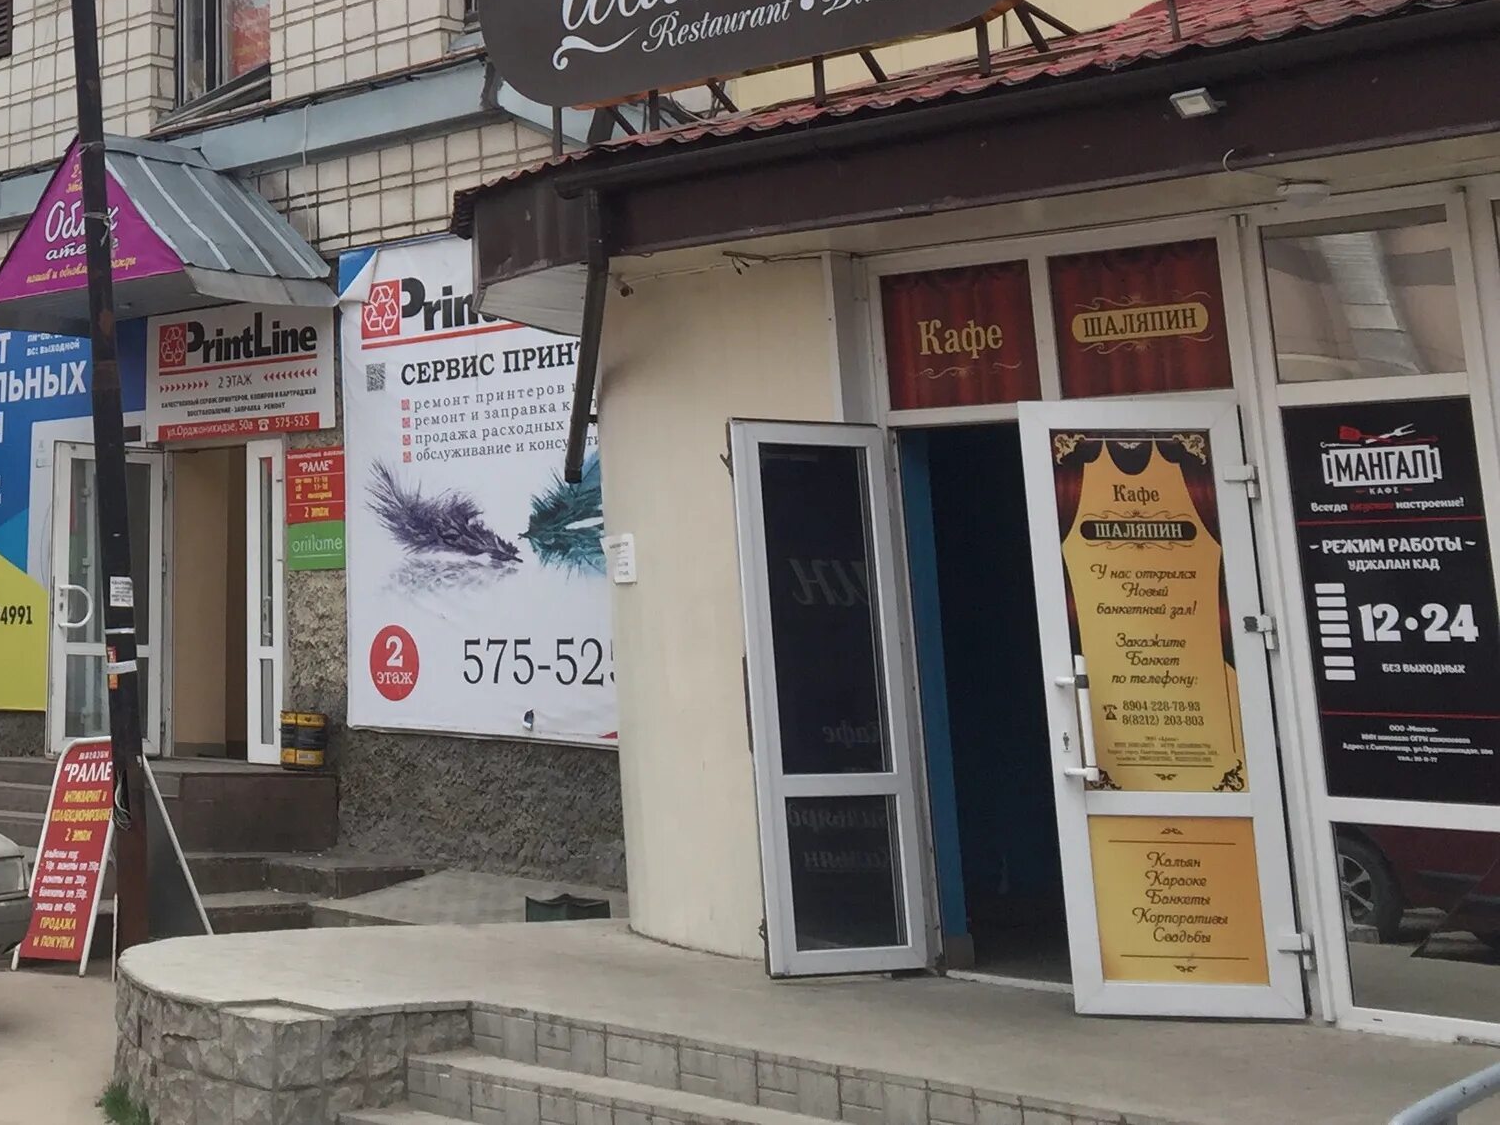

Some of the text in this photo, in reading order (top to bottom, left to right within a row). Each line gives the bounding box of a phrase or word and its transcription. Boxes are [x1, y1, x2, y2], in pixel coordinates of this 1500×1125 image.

[66, 179, 83, 193] эта
[1082, 307, 1198, 338] ШАЛЯПИН
[187, 311, 318, 363] PrintLine
[917, 318, 1003, 360] Кафе
[40, 338, 80, 354] ВЫХОДНОЙ
[401, 354, 495, 386] СЕРВИС
[218, 374, 253, 389] 2 ЭТАЖ
[414, 383, 565, 413] ремонт принтеров
[275, 416, 310, 428] 575-525
[415, 411, 466, 430] ремонт
[471, 411, 479, 421] и
[484, 401, 557, 422] заправка
[415, 420, 565, 446] продажа расходных
[416, 442, 512, 463] обслуживание
[516, 443, 525, 452] и
[1112, 484, 1160, 506] Кафе
[1369, 487, 1400, 495] КАФЕ
[304, 506, 309, 518] 2
[1311, 501, 1348, 513] Всегда
[1396, 497, 1465, 511] настроение!
[1094, 523, 1183, 538] ШАЛЯПИН
[291, 534, 343, 553] oriflame
[1322, 536, 1463, 554] РЕЖИМ РАБОТЫ
[1090, 563, 1197, 583] У нас открылся
[1347, 558, 1441, 573] УДЖАЛАН КАД
[1121, 582, 1169, 598] Новый
[1096, 600, 1198, 619] банкетный зал!
[1115, 632, 1187, 648] Закажите
[385, 635, 403, 667] 2
[1125, 651, 1180, 666] Банкет
[1111, 666, 1199, 688] по телефону:
[1382, 663, 1466, 675] БЕЗ ВЫХОДНЫХ
[376, 671, 413, 686] этаж
[1122, 700, 1201, 712] 8904 228-78-93
[1122, 714, 1204, 727] 8(8212) 203-803
[65, 828, 71, 842] 2
[1146, 851, 1201, 868] Кальян
[1145, 870, 1207, 890] Караоке
[1145, 888, 1211, 905] Банкеты
[40, 917, 76, 931] ПРОДАЖА
[1132, 907, 1229, 927] Корпоративы
[40, 935, 76, 949] ПОКУПКА
[1153, 926, 1212, 943] Свадьбы
